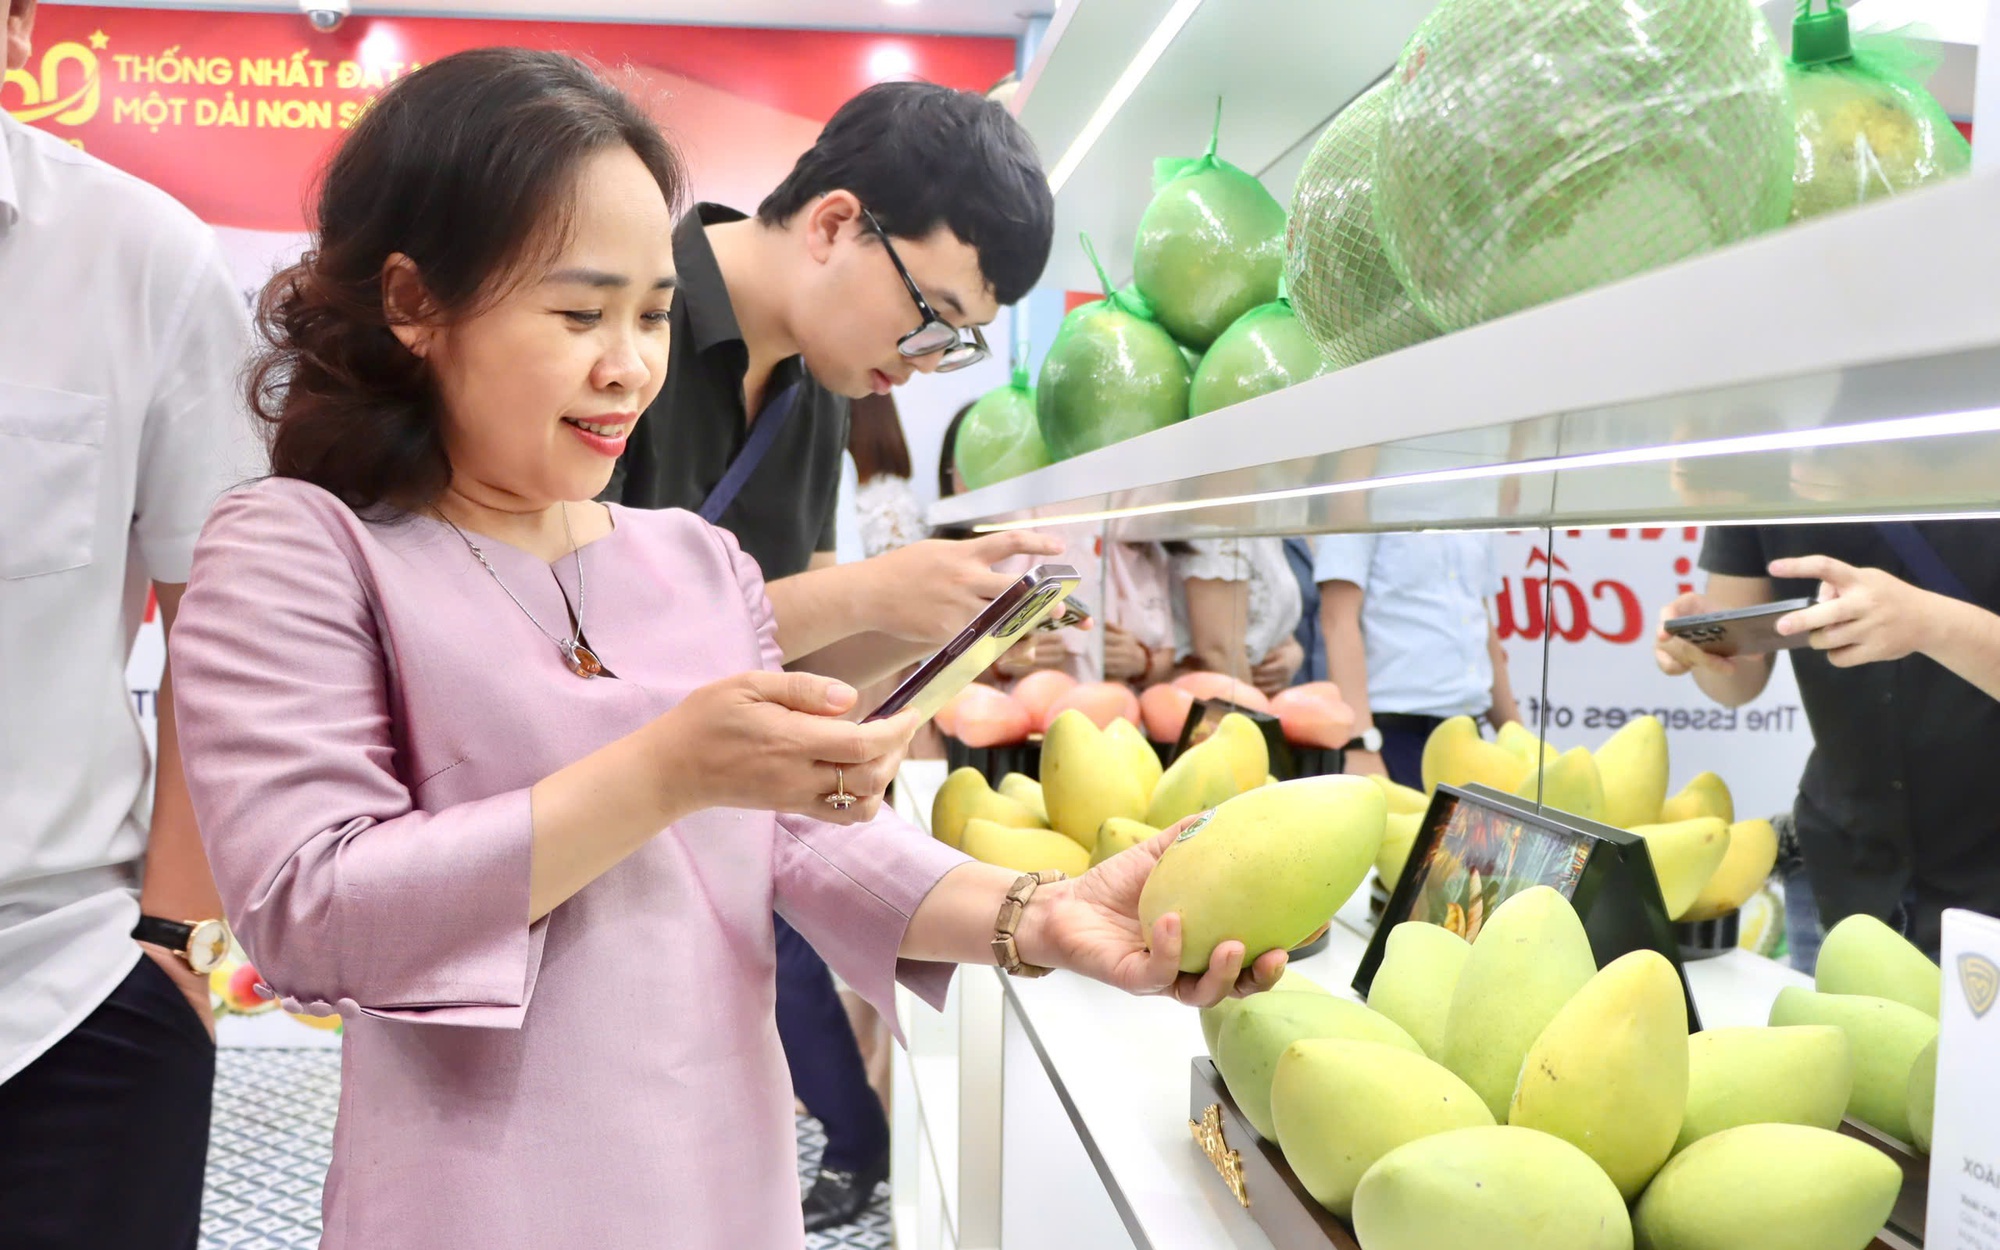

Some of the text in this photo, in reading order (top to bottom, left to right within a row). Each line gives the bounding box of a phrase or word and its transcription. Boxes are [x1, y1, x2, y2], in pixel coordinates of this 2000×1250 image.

[112, 44, 233, 85] THỐNG
[240, 48, 329, 87] NHẤT
[113, 90, 188, 133] MỘT
[195, 90, 249, 127] DẢI
[256, 100, 331, 129] NON
